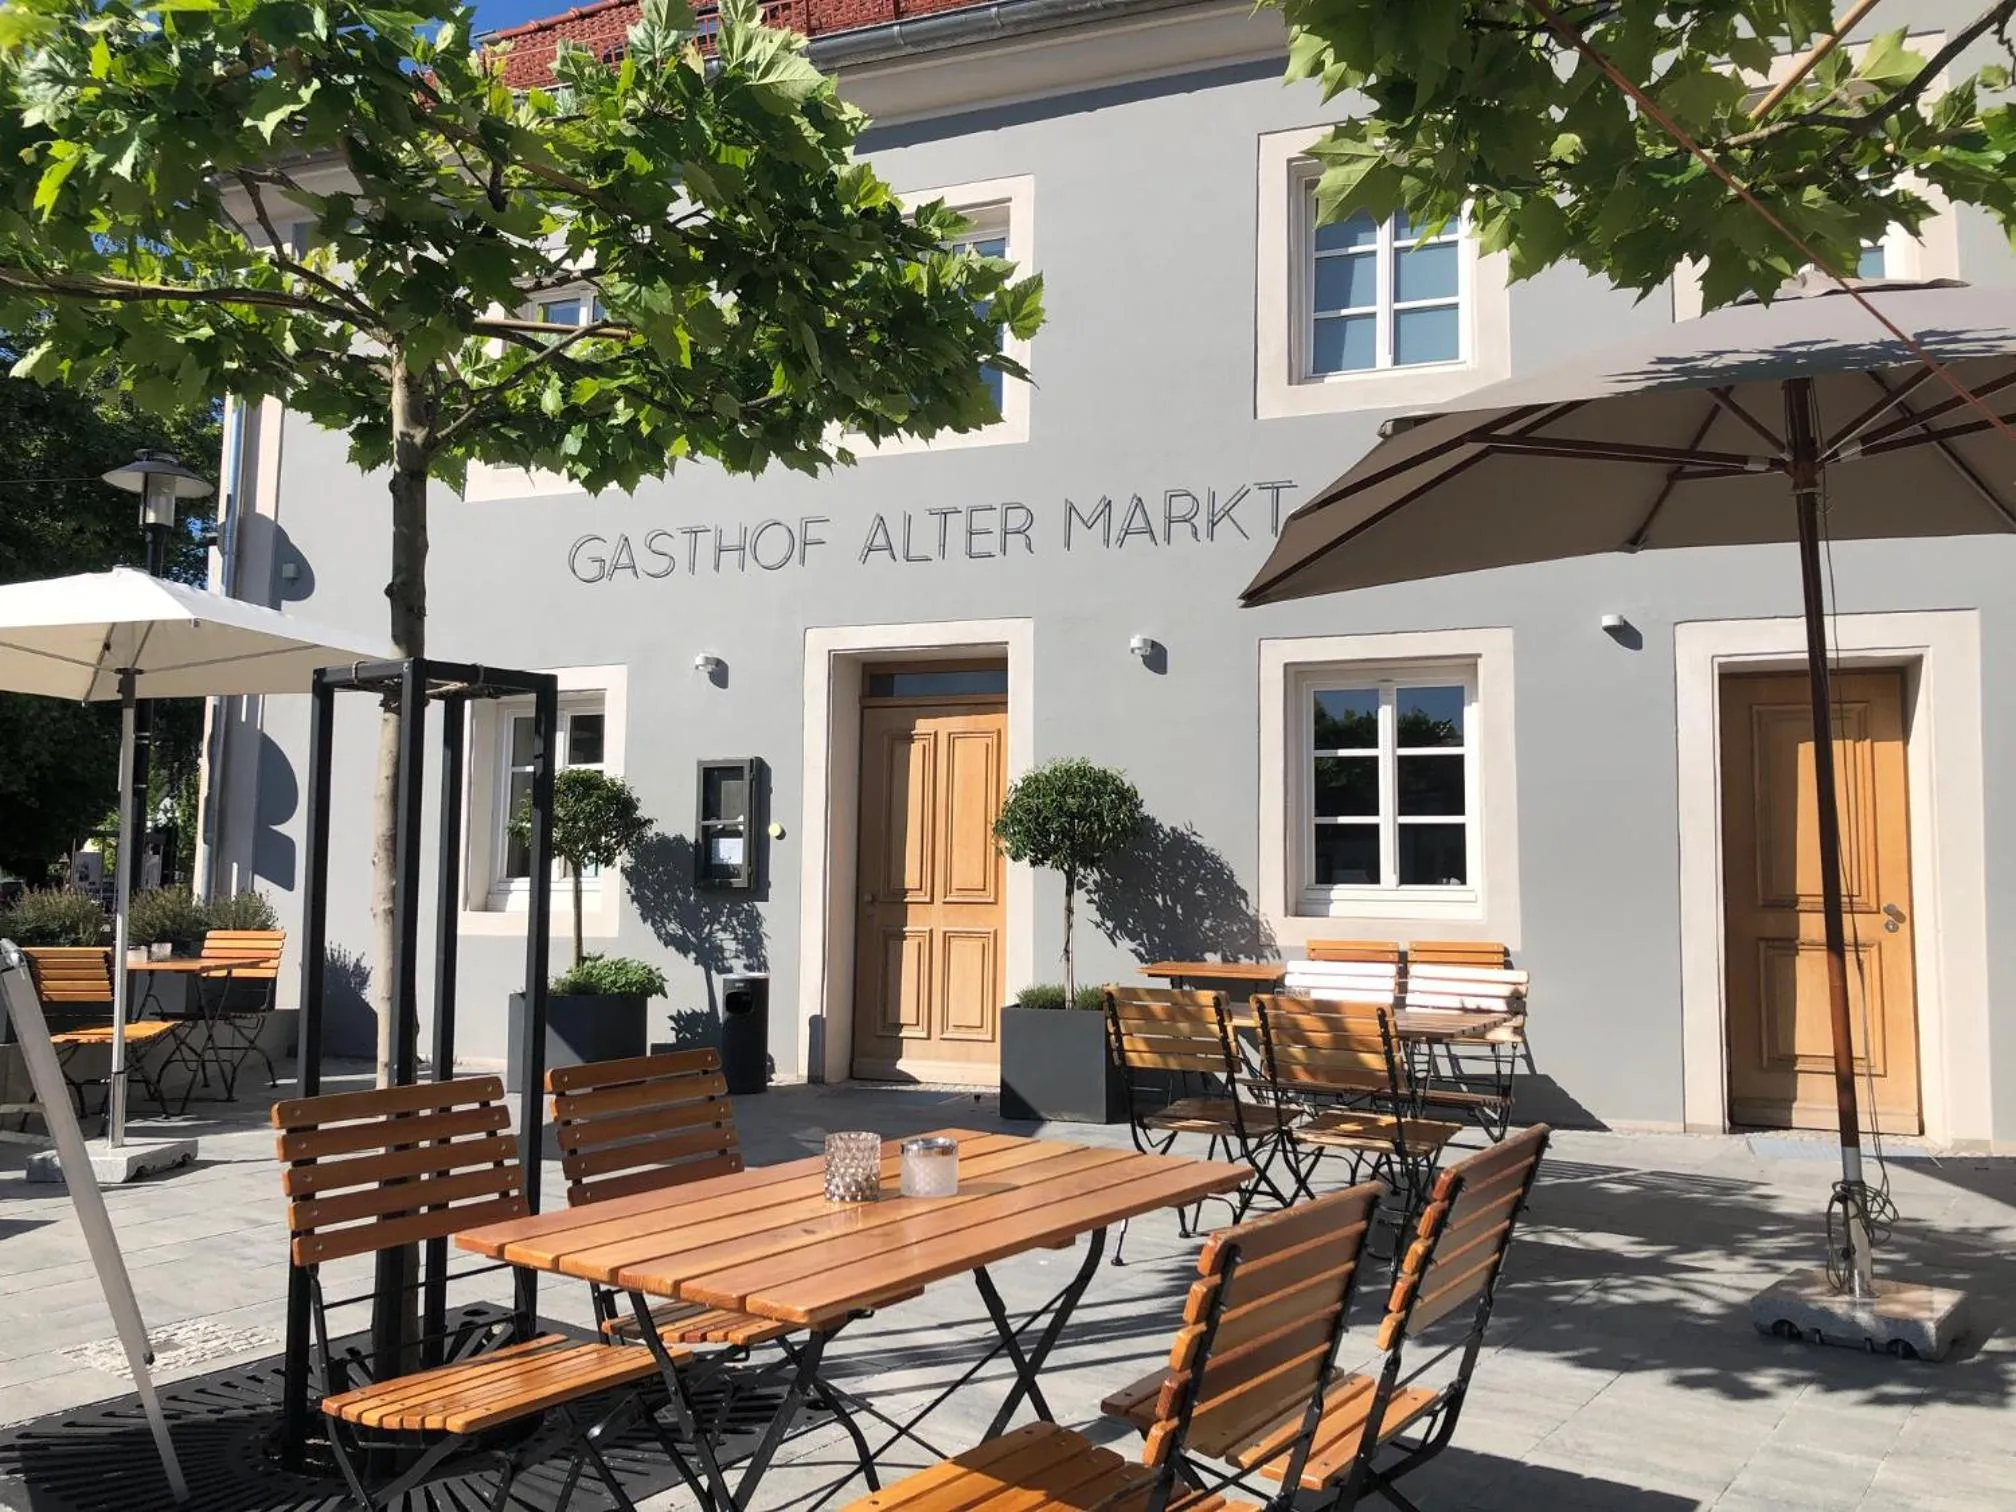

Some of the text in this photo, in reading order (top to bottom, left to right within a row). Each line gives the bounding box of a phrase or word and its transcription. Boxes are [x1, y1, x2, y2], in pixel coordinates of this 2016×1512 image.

[569, 480, 1299, 583] GASTHOF ALTER MARKT
